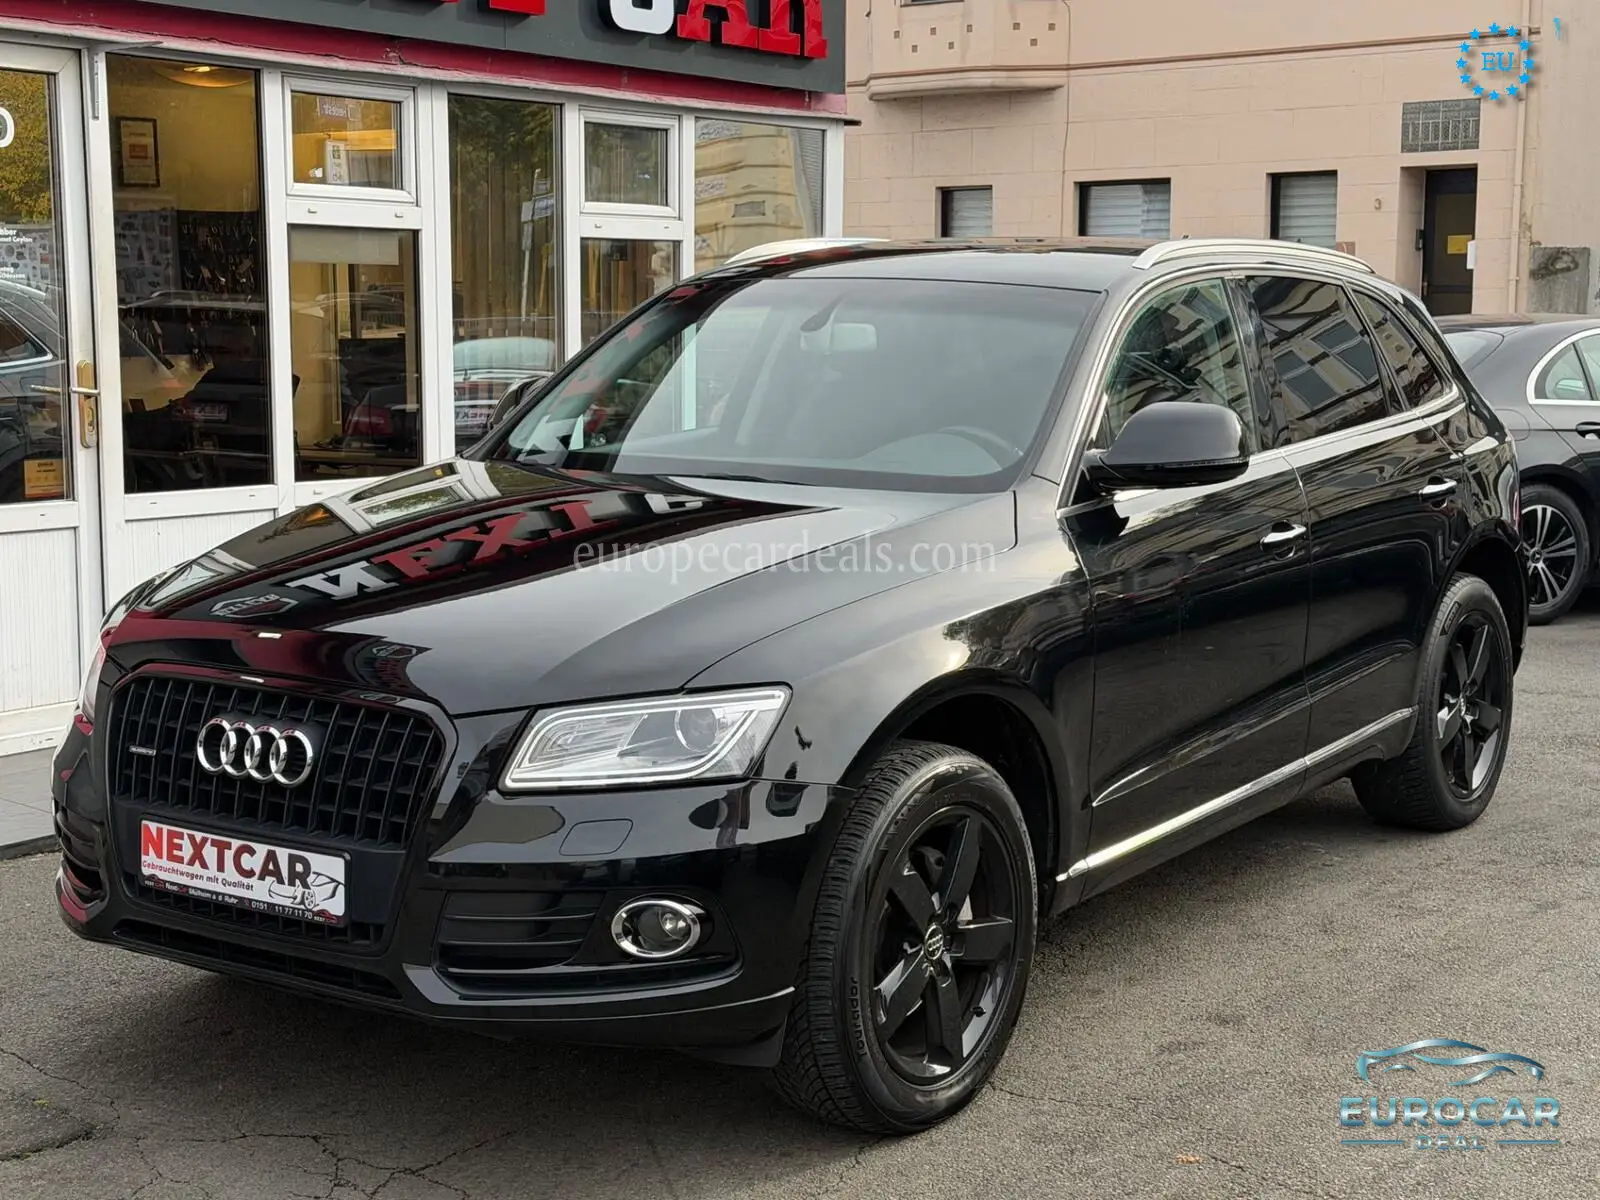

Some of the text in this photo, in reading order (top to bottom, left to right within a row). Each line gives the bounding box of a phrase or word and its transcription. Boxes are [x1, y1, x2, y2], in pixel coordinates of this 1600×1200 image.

[1374, 198, 1382, 210] 3
[142, 823, 312, 889] NEXTCAR
[142, 860, 254, 892] Gebrauchtwagen mit Qualität
